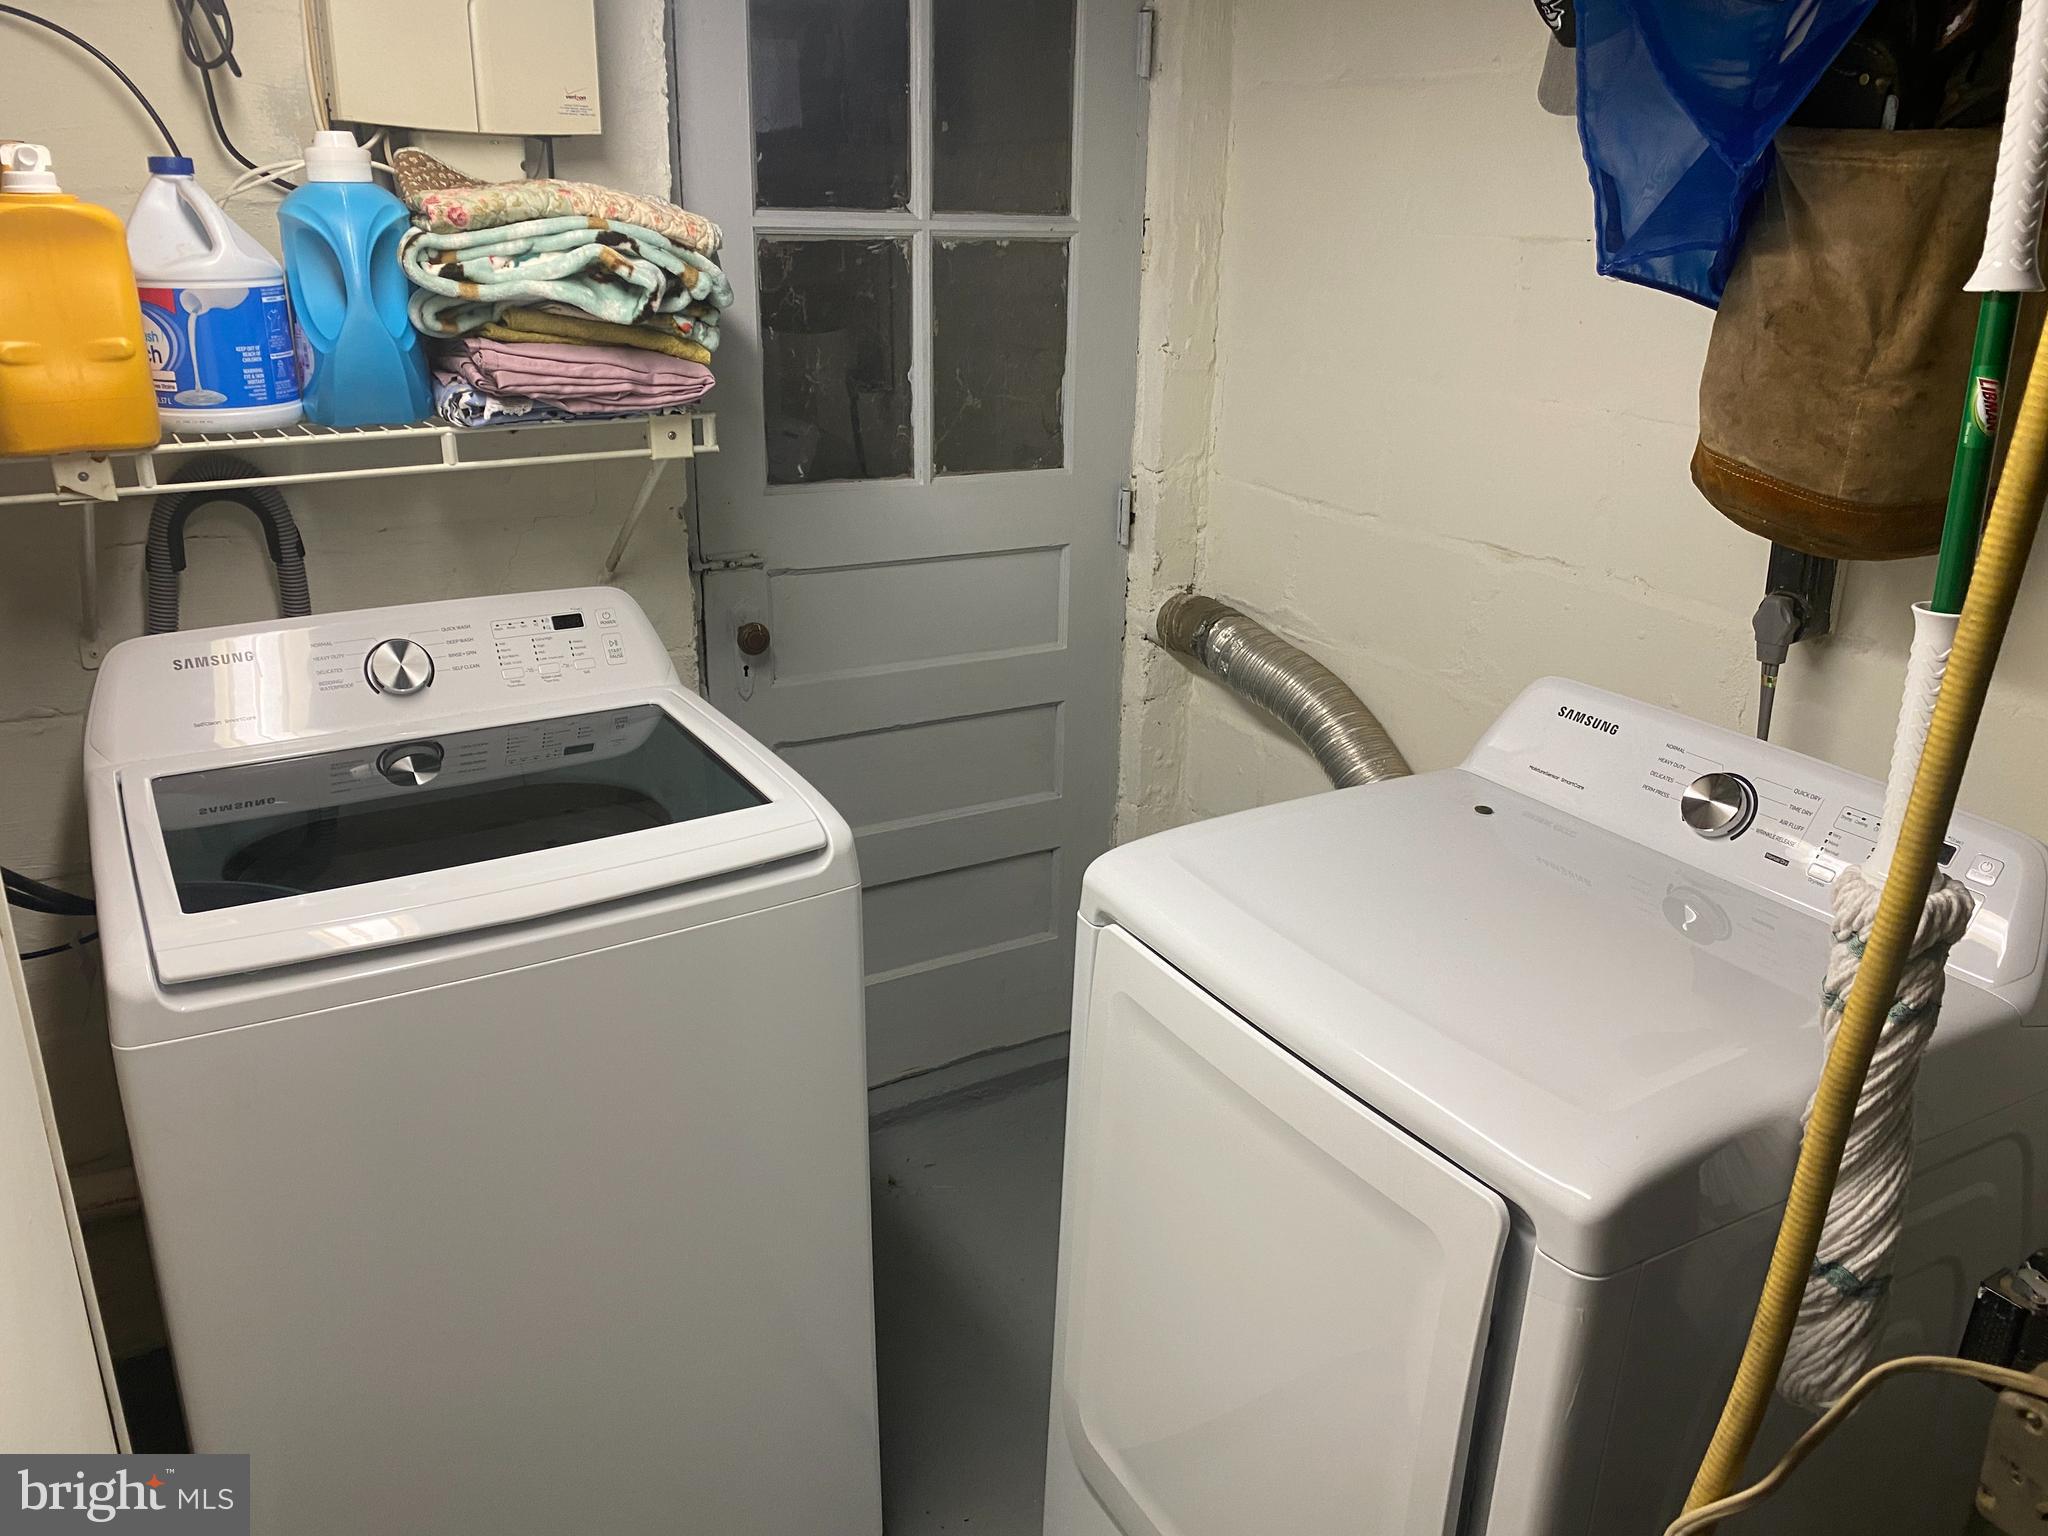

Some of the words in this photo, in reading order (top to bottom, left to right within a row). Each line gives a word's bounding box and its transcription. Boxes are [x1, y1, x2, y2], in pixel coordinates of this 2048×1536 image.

[1979, 378, 1999, 432] LIBMAN
[172, 651, 254, 671] SAMSUNG
[1557, 706, 1619, 736] SAMSUNG
[1666, 743, 1685, 754] NORMAL
[1658, 757, 1673, 766] HEAVY
[1672, 762, 1686, 770] DUTY
[1650, 770, 1674, 783] DELICATES
[1642, 784, 1656, 793] PERM
[1655, 789, 1670, 799] PRESS
[1793, 788, 1809, 799] QUICK
[1809, 793, 1822, 801] DRY
[1789, 804, 1802, 813] TIME
[1801, 809, 1814, 817] DRY
[1788, 822, 1805, 831] FLUFF
[1756, 828, 1776, 839] WRINKLE
[1775, 835, 1796, 847] RELEASE
